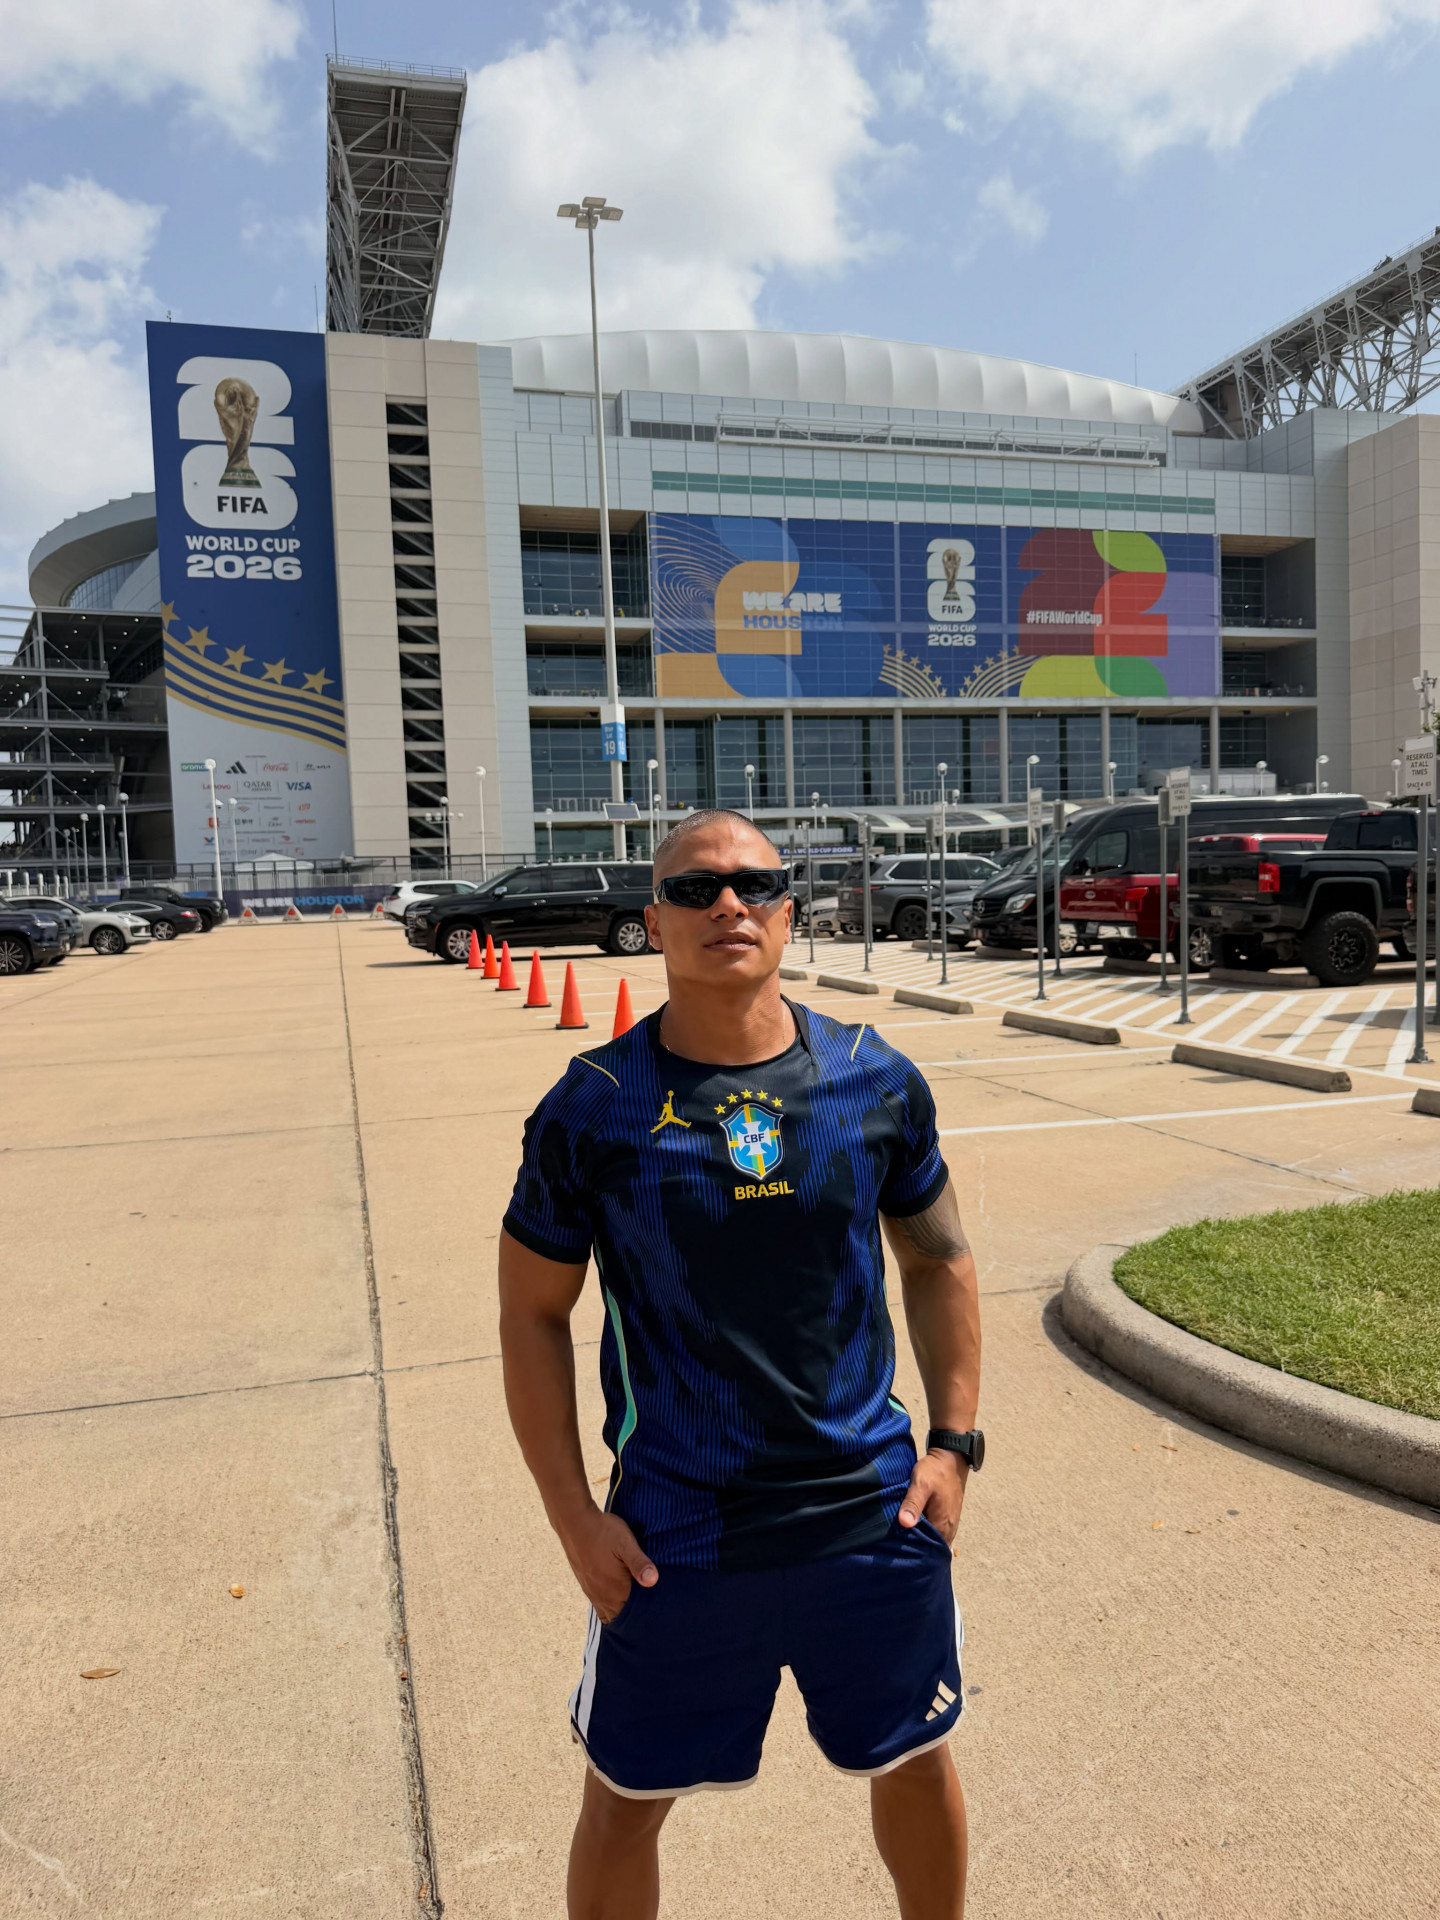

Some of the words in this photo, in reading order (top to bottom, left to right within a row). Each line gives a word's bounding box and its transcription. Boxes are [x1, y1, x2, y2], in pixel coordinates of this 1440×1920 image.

[217, 495, 269, 514] FIFA
[185, 535, 259, 552] WORLD
[261, 537, 301, 553] CUP
[186, 554, 302, 581] 2026
[742, 591, 784, 611] WE
[942, 605, 963, 614] FIFA
[743, 614, 844, 630] HOUSTON
[1026, 610, 1103, 627] #FIFAWorldCup
[928, 624, 959, 633] WORLD
[960, 624, 977, 633] CUP
[928, 634, 976, 646] 2026
[604, 740, 616, 756] 19
[1406, 752, 1434, 760] RESERVED
[1411, 768, 1428, 776] TIMES
[244, 780, 271, 789] QATAR
[286, 781, 312, 791] VISA
[241, 898, 265, 908] WE
[294, 895, 365, 906] HOUSTON
[743, 1132, 765, 1144] CBF
[734, 1180, 795, 1201] BRASIL
